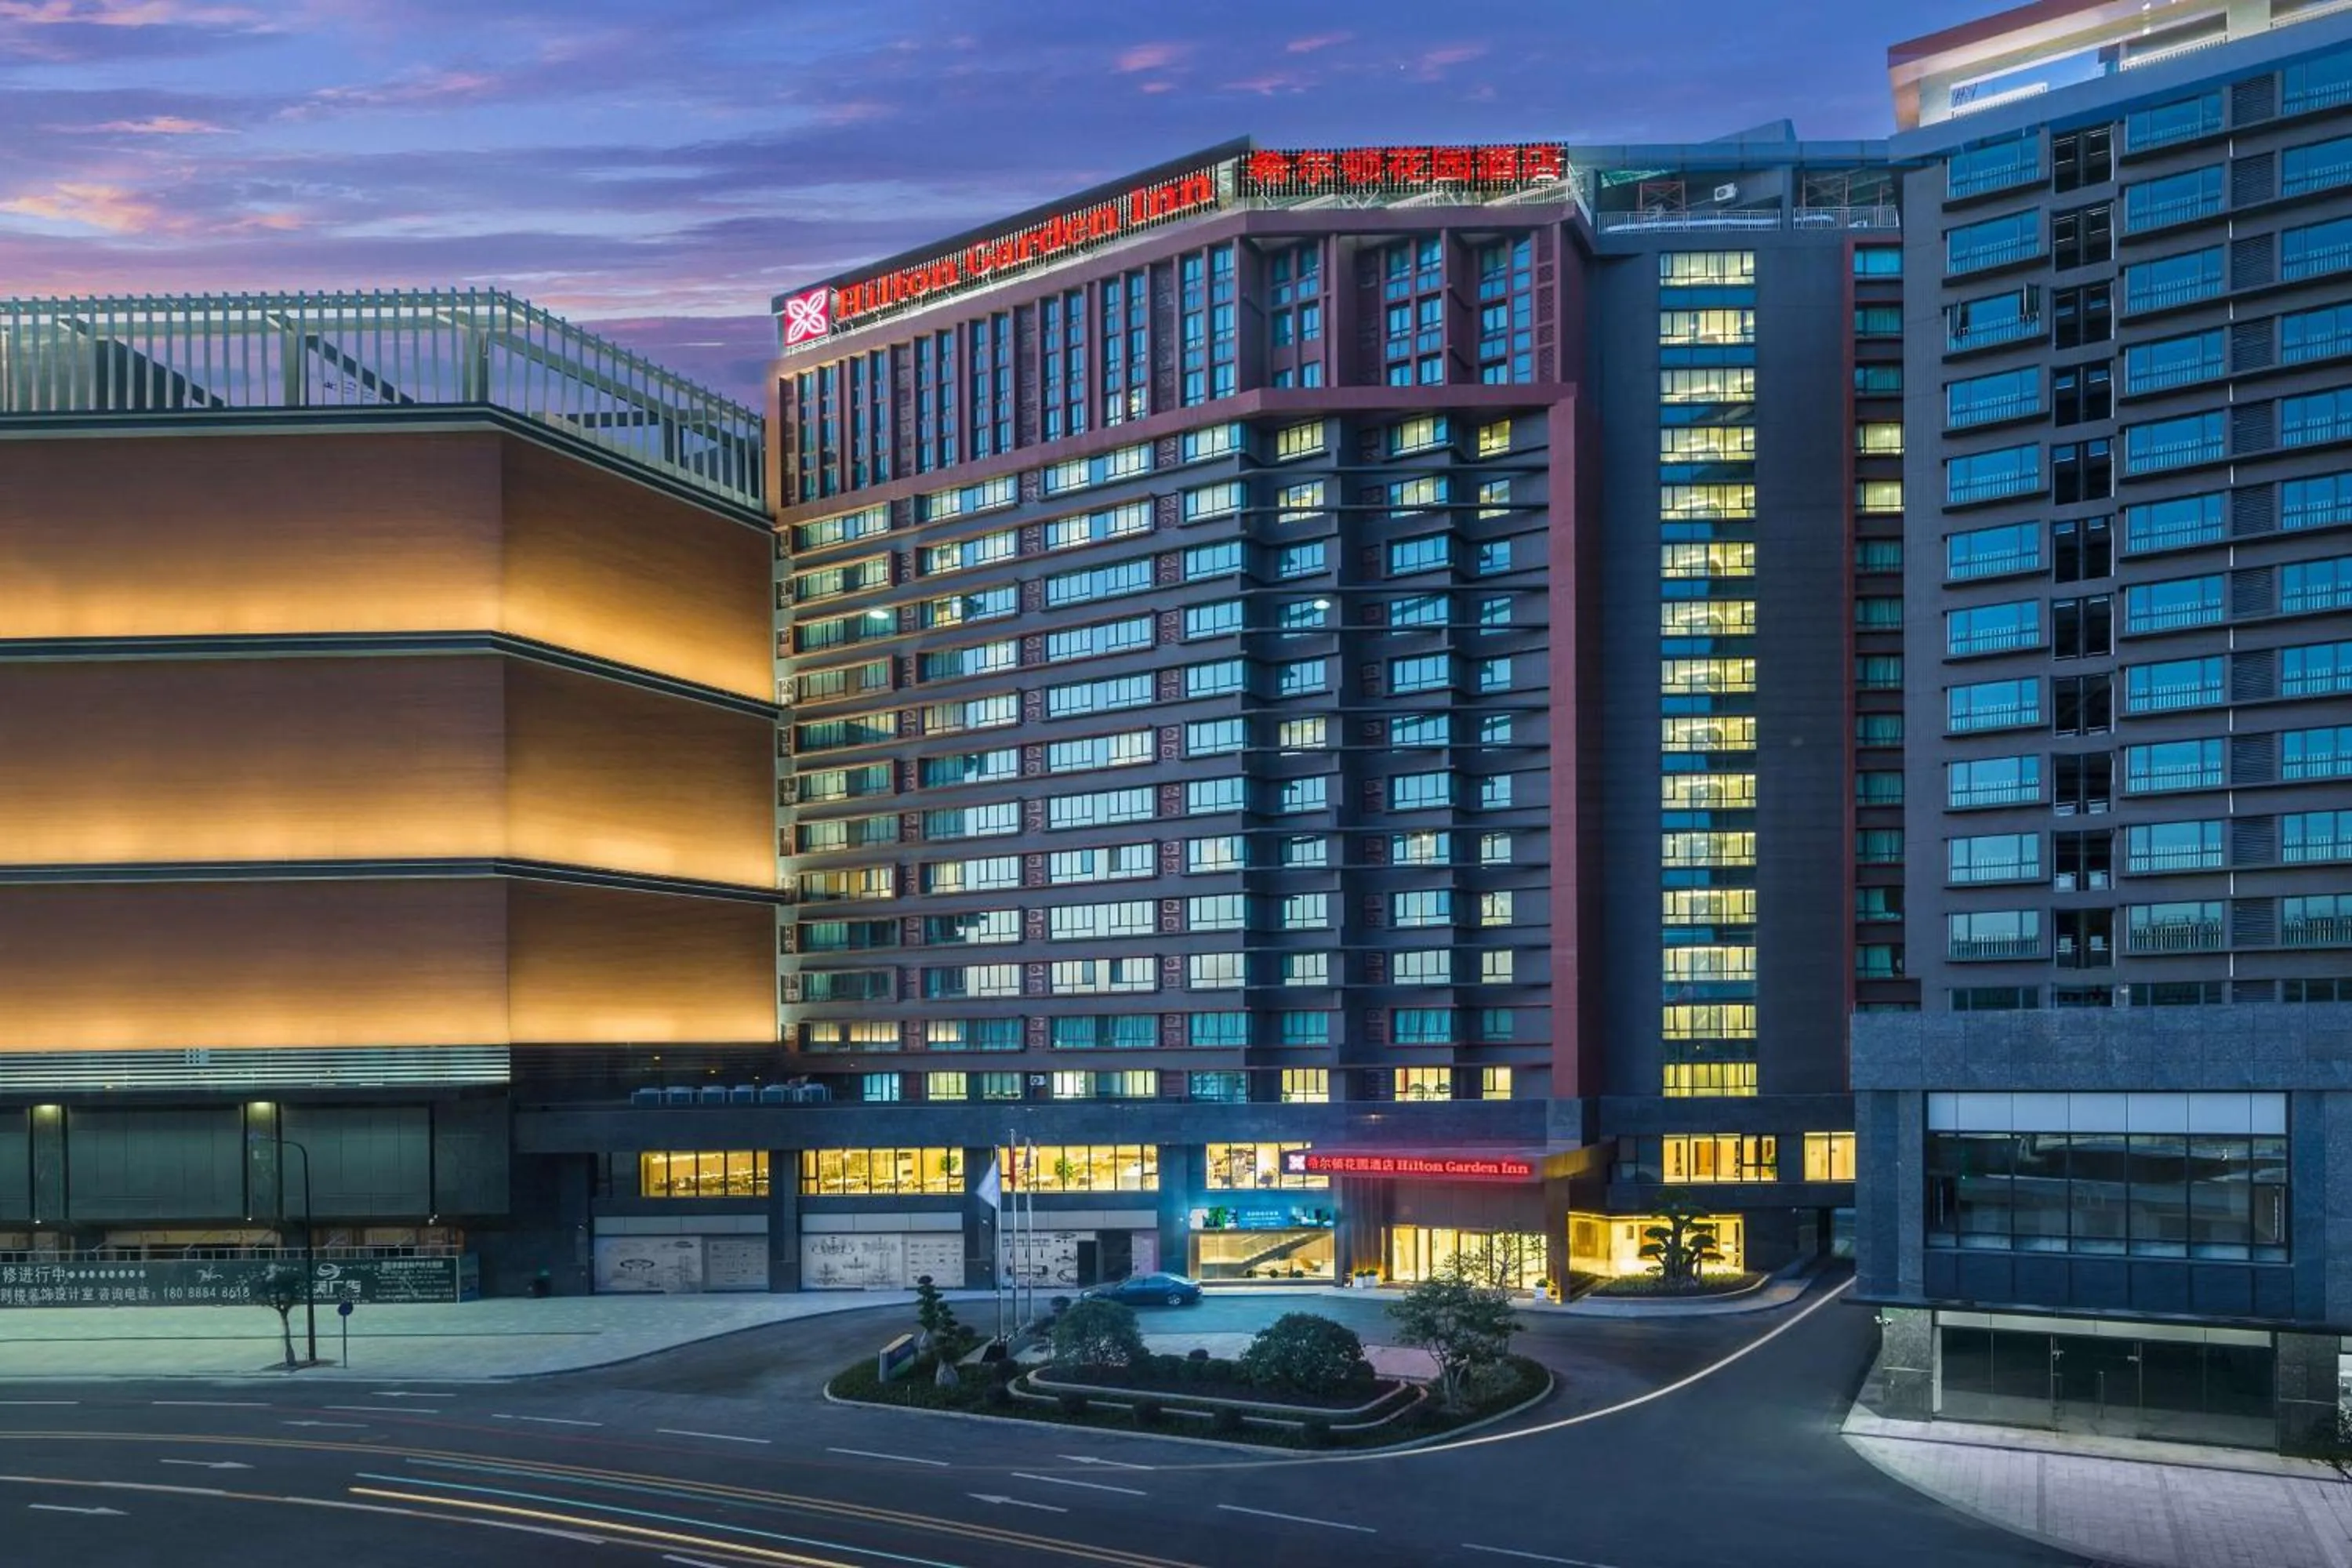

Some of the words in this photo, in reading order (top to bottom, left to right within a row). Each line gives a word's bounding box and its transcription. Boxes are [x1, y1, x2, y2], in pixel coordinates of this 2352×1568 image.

[1249, 147, 1562, 185] 希尔顿花园酒店
[838, 262, 958, 320] Hilton
[965, 205, 1119, 274] Garden
[1130, 173, 1212, 223] Inn
[1307, 1156, 1394, 1171] 希尔顿花园酒店
[1397, 1160, 1443, 1173] Hilton
[1446, 1161, 1498, 1174] Garden
[1501, 1163, 1528, 1174] Inn
